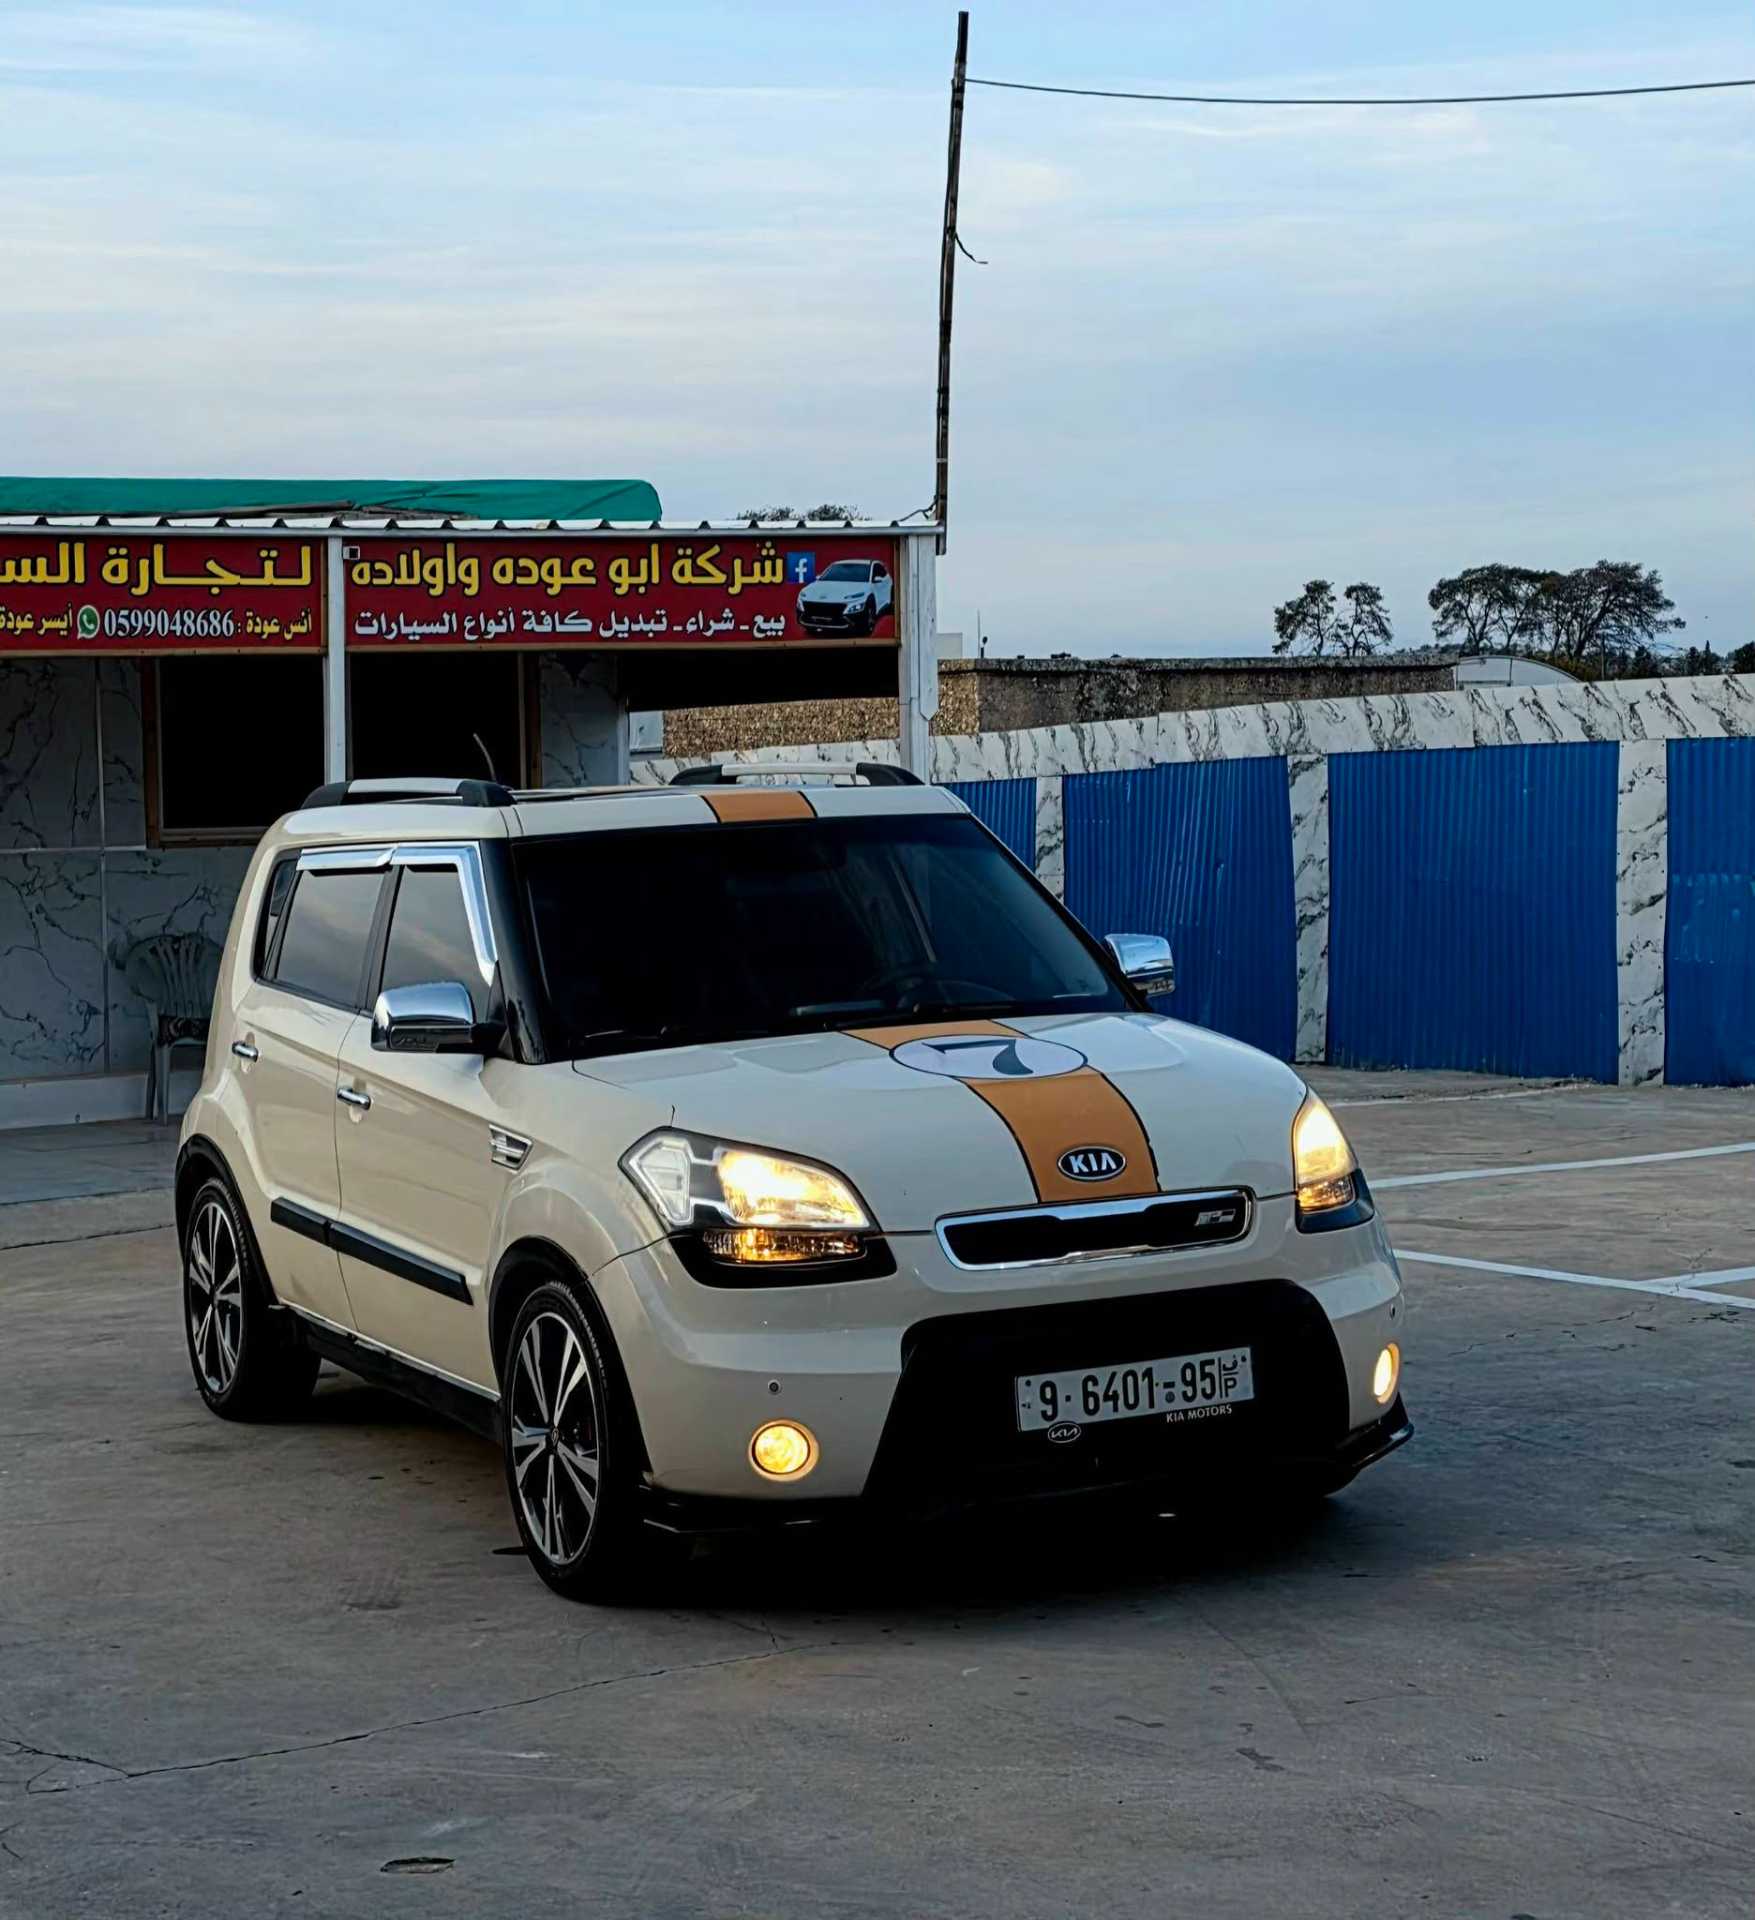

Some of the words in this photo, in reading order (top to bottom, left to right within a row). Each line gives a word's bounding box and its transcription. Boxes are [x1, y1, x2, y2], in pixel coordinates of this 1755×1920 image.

[0, 542, 85, 584] الس
[102, 545, 311, 595] لتجارة
[352, 542, 479, 596] واولاده
[493, 557, 596, 596] عوده
[609, 543, 659, 595] ابو
[672, 541, 783, 595] شركة
[104, 608, 234, 637] 0599048686
[355, 611, 457, 640] السيارات
[464, 607, 515, 640] أنواع
[522, 610, 592, 633] كافة
[599, 609, 668, 638] تبديل
[1069, 1154, 1117, 1174] KIA
[1166, 1411, 1185, 1424] KIA
[1187, 1403, 1233, 1420] MOTORS
